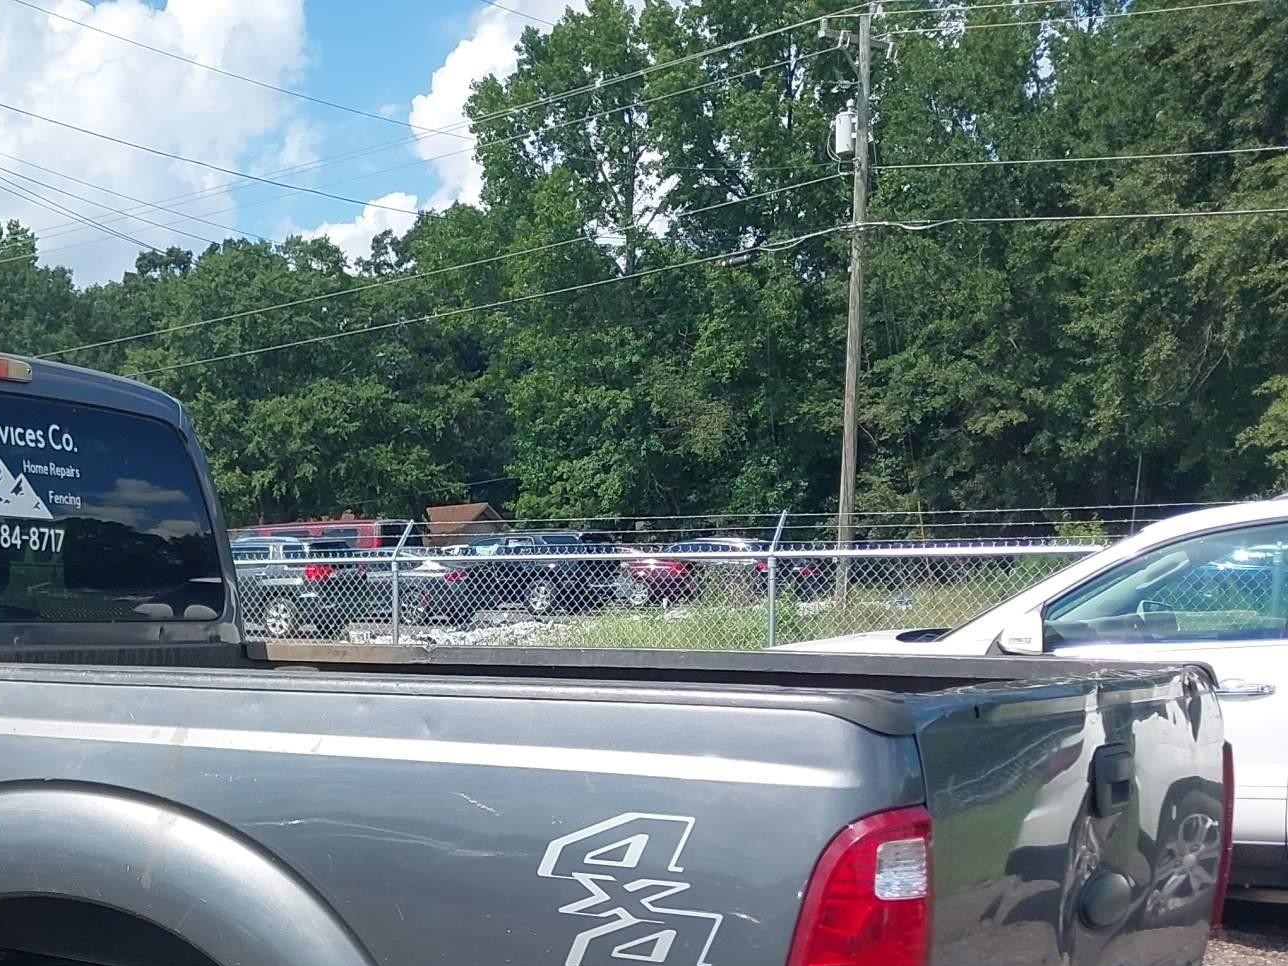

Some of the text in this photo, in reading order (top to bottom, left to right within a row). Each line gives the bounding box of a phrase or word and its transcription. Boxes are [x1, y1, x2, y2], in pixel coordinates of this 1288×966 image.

[48, 424, 79, 453] Co.
[22, 460, 81, 480] Home Repairs
[48, 490, 82, 510] Fencing
